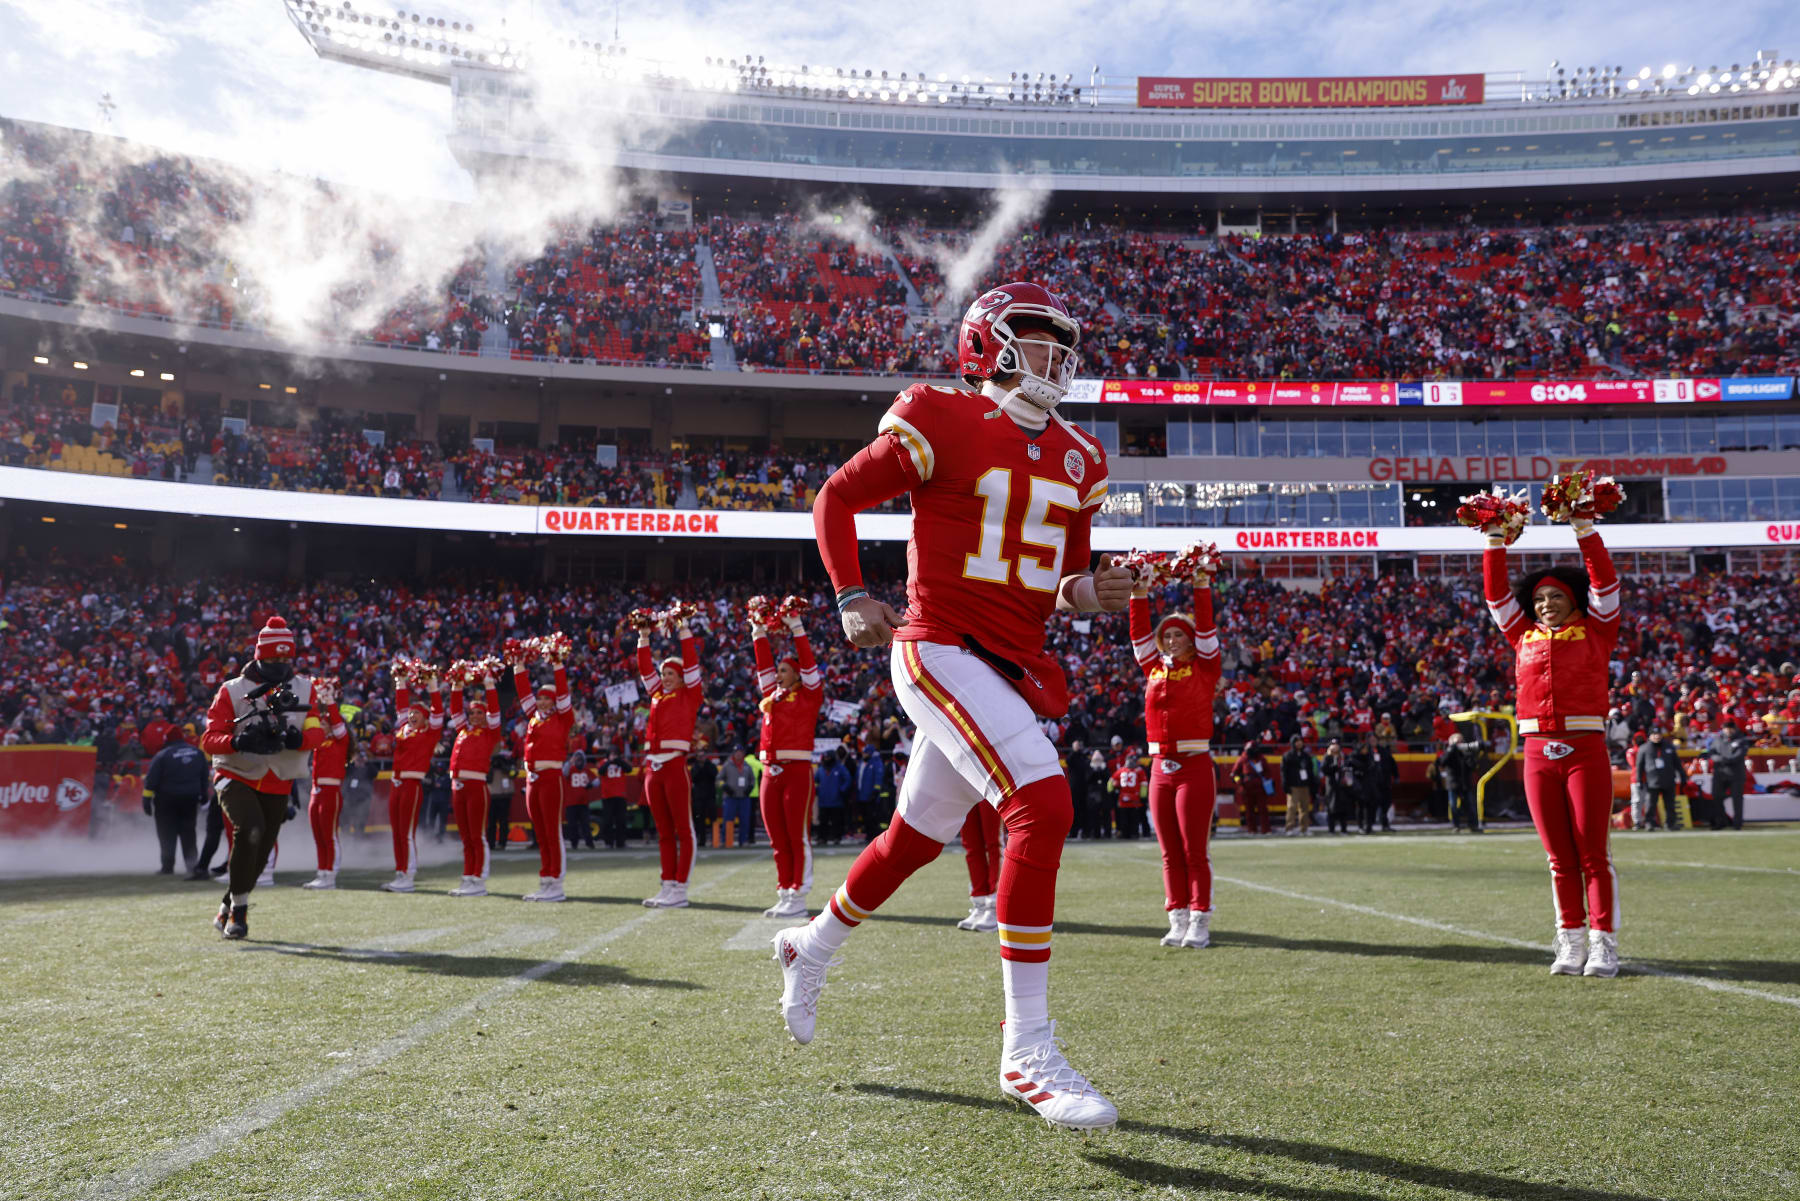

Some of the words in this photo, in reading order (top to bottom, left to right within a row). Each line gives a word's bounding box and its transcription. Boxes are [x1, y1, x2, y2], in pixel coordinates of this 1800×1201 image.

[1193, 82, 1252, 103] SUPER
[1259, 82, 1312, 103] BOWL
[1318, 80, 1427, 102] CHAMPIONS
[1105, 382, 1121, 391] KC
[1173, 382, 1199, 392] 0:00
[1431, 384, 1440, 403] 0
[1530, 384, 1587, 402] 6:04
[1677, 381, 1688, 400] 0
[1728, 384, 1752, 394] BUD
[1754, 383, 1786, 393] LIGHT
[1105, 392, 1129, 402] SEA
[1173, 393, 1199, 403] 0:00
[1368, 457, 1458, 481] GEHA
[1466, 456, 1553, 480] FIELD
[1579, 456, 1727, 476] ARROWHEAD
[545, 511, 719, 533] QUARTERBACK
[962, 467, 1081, 594] 15
[1236, 531, 1379, 550] QUARTERBACK
